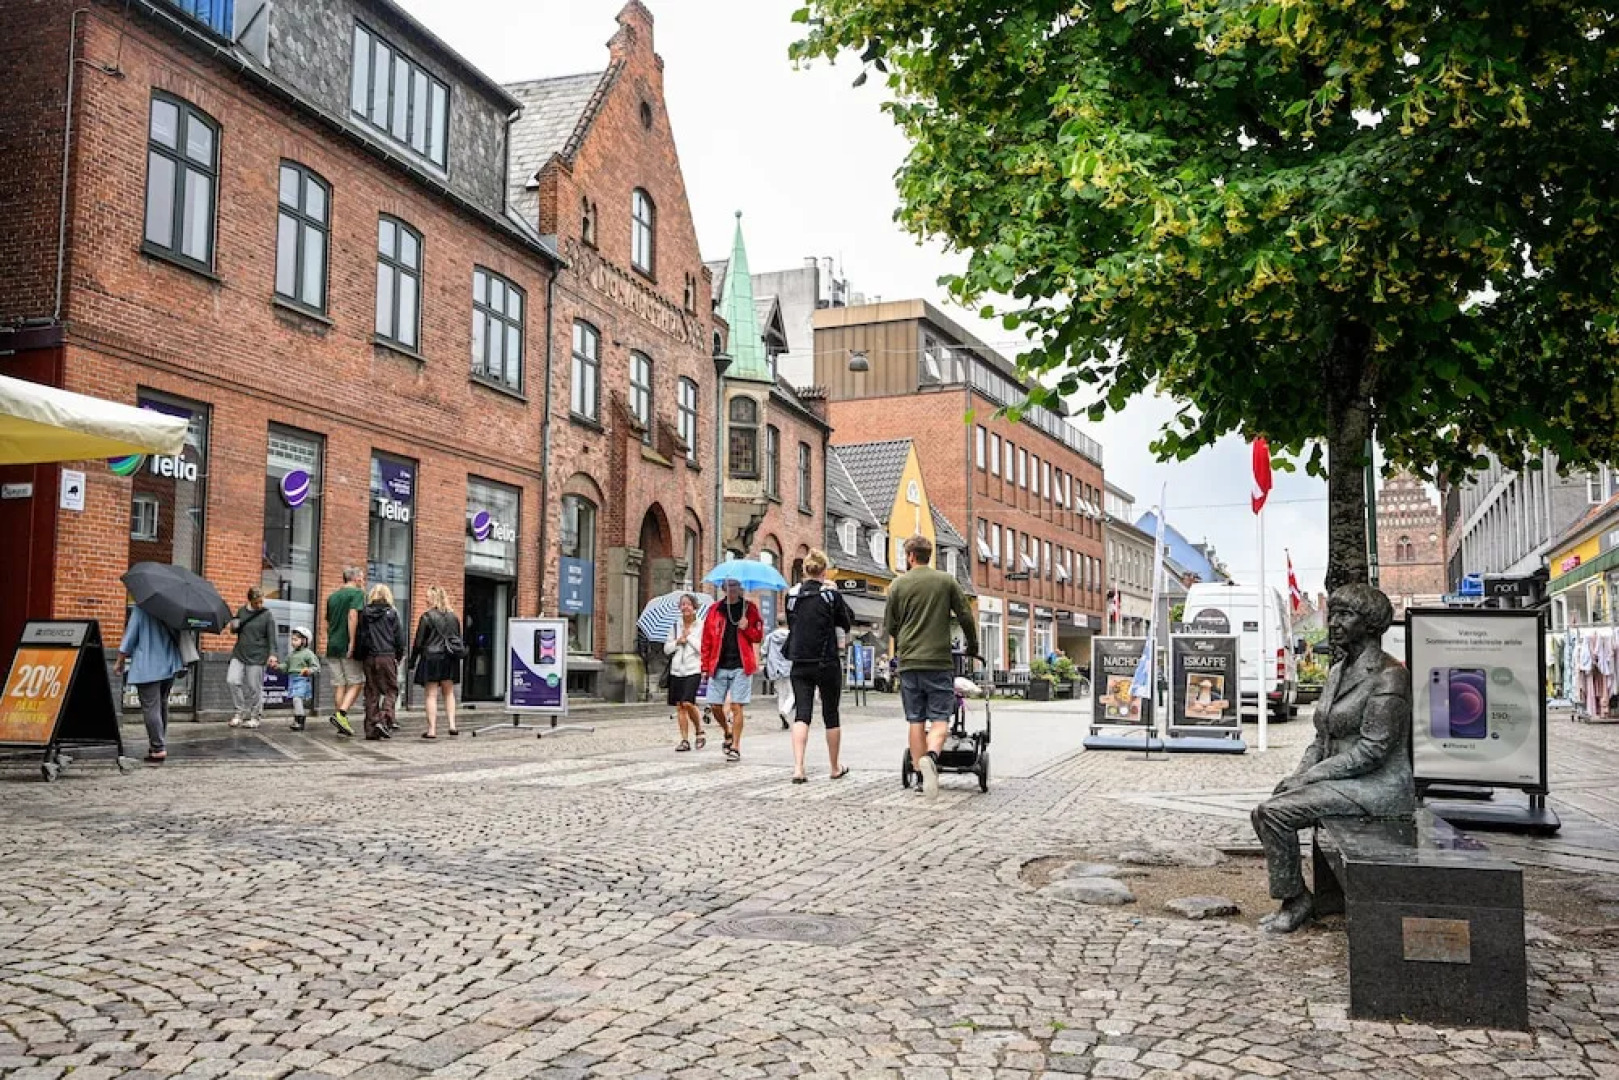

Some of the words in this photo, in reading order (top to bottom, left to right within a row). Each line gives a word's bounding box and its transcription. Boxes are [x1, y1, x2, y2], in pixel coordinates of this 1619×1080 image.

[152, 454, 197, 481] Telia
[376, 497, 409, 522] Telia
[491, 522, 516, 542] Telia
[1103, 656, 1139, 667] NACHO
[1183, 656, 1227, 668] ISKAFFE
[11, 665, 61, 698] 20%
